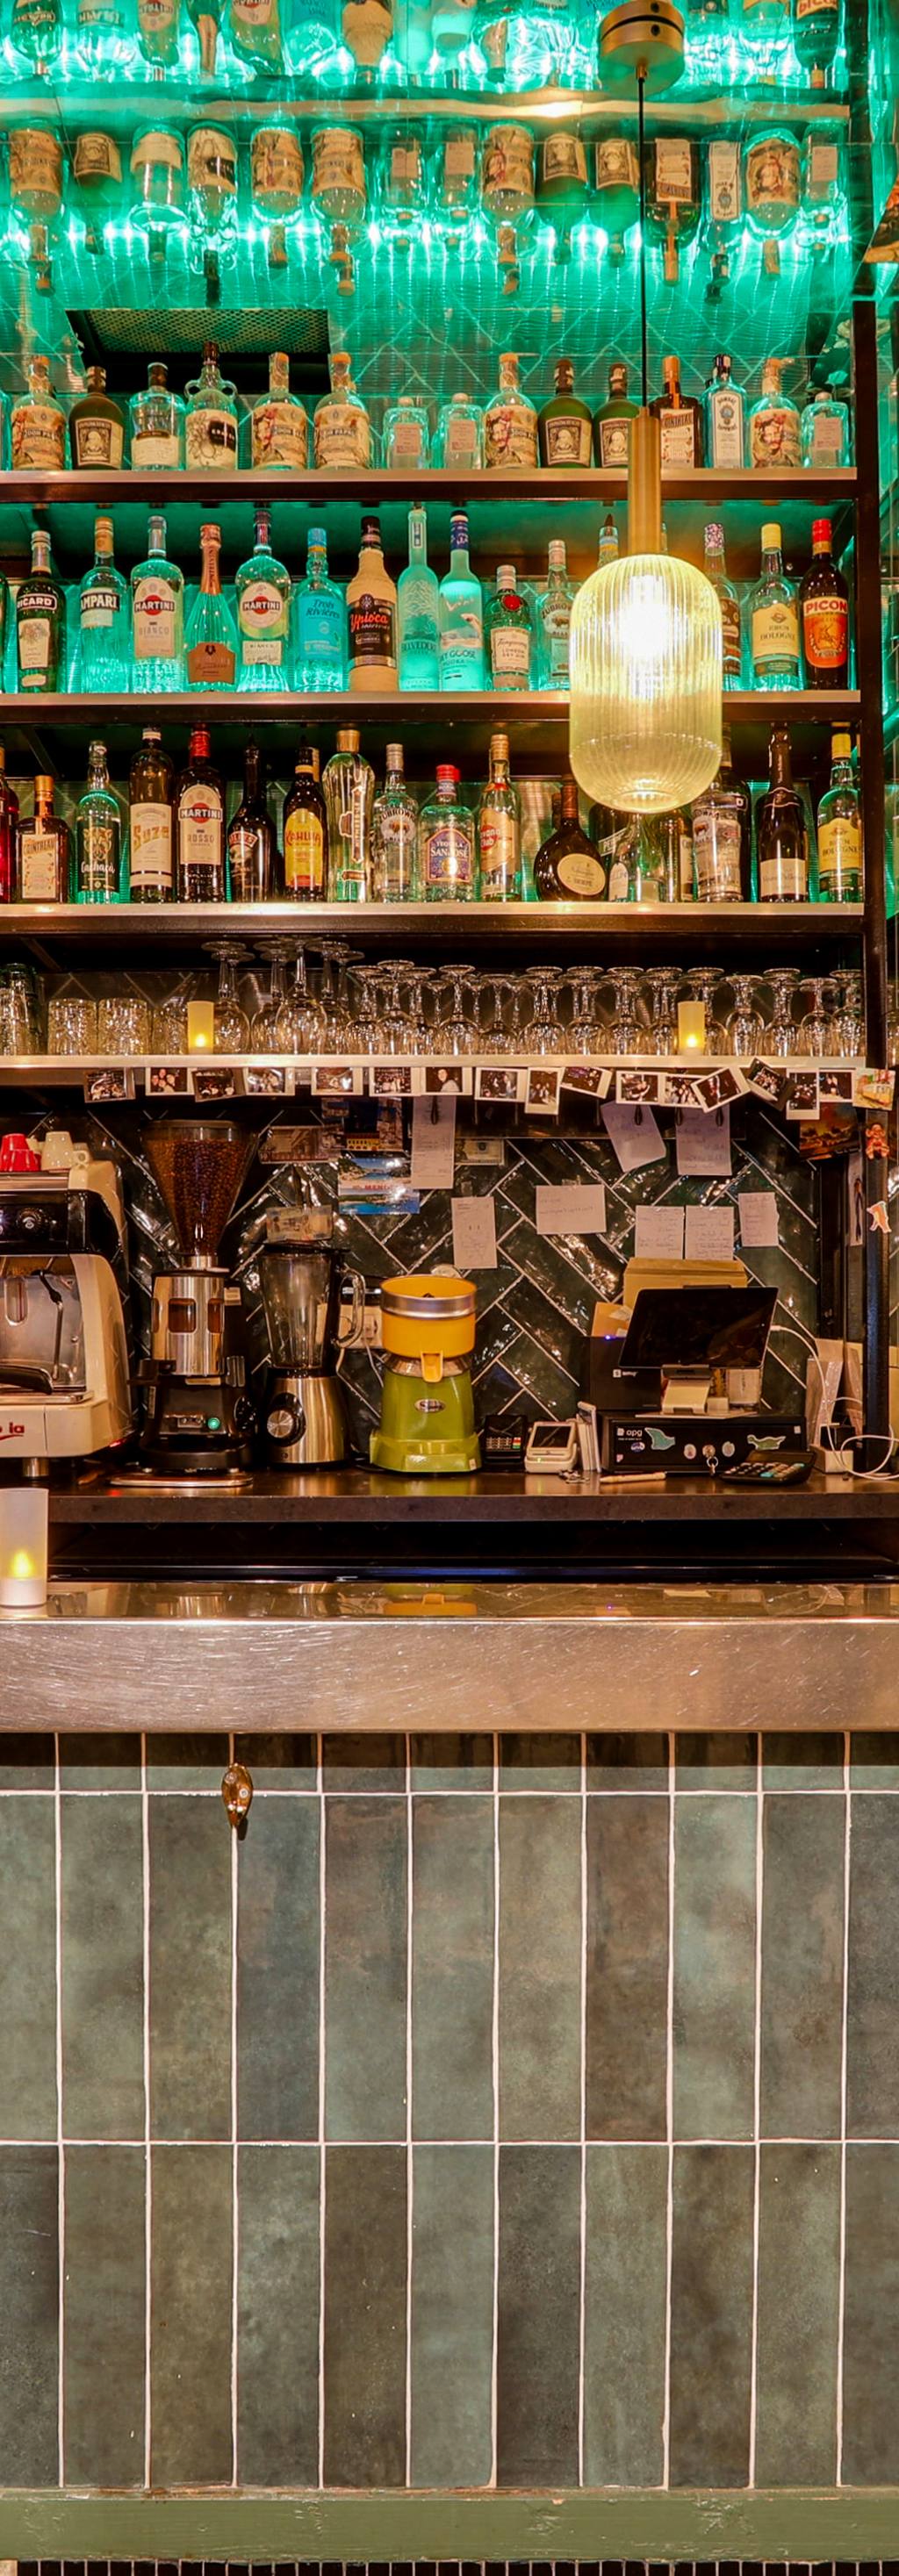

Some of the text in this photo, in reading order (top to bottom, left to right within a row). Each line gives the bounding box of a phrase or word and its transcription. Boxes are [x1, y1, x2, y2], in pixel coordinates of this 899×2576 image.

[81, 595, 118, 609] AMPARI
[134, 600, 175, 612] MARTINI
[243, 600, 280, 611] MARTINI
[806, 600, 847, 613] PICON
[179, 808, 222, 819] MARTINI
[133, 824, 170, 853] Suze
